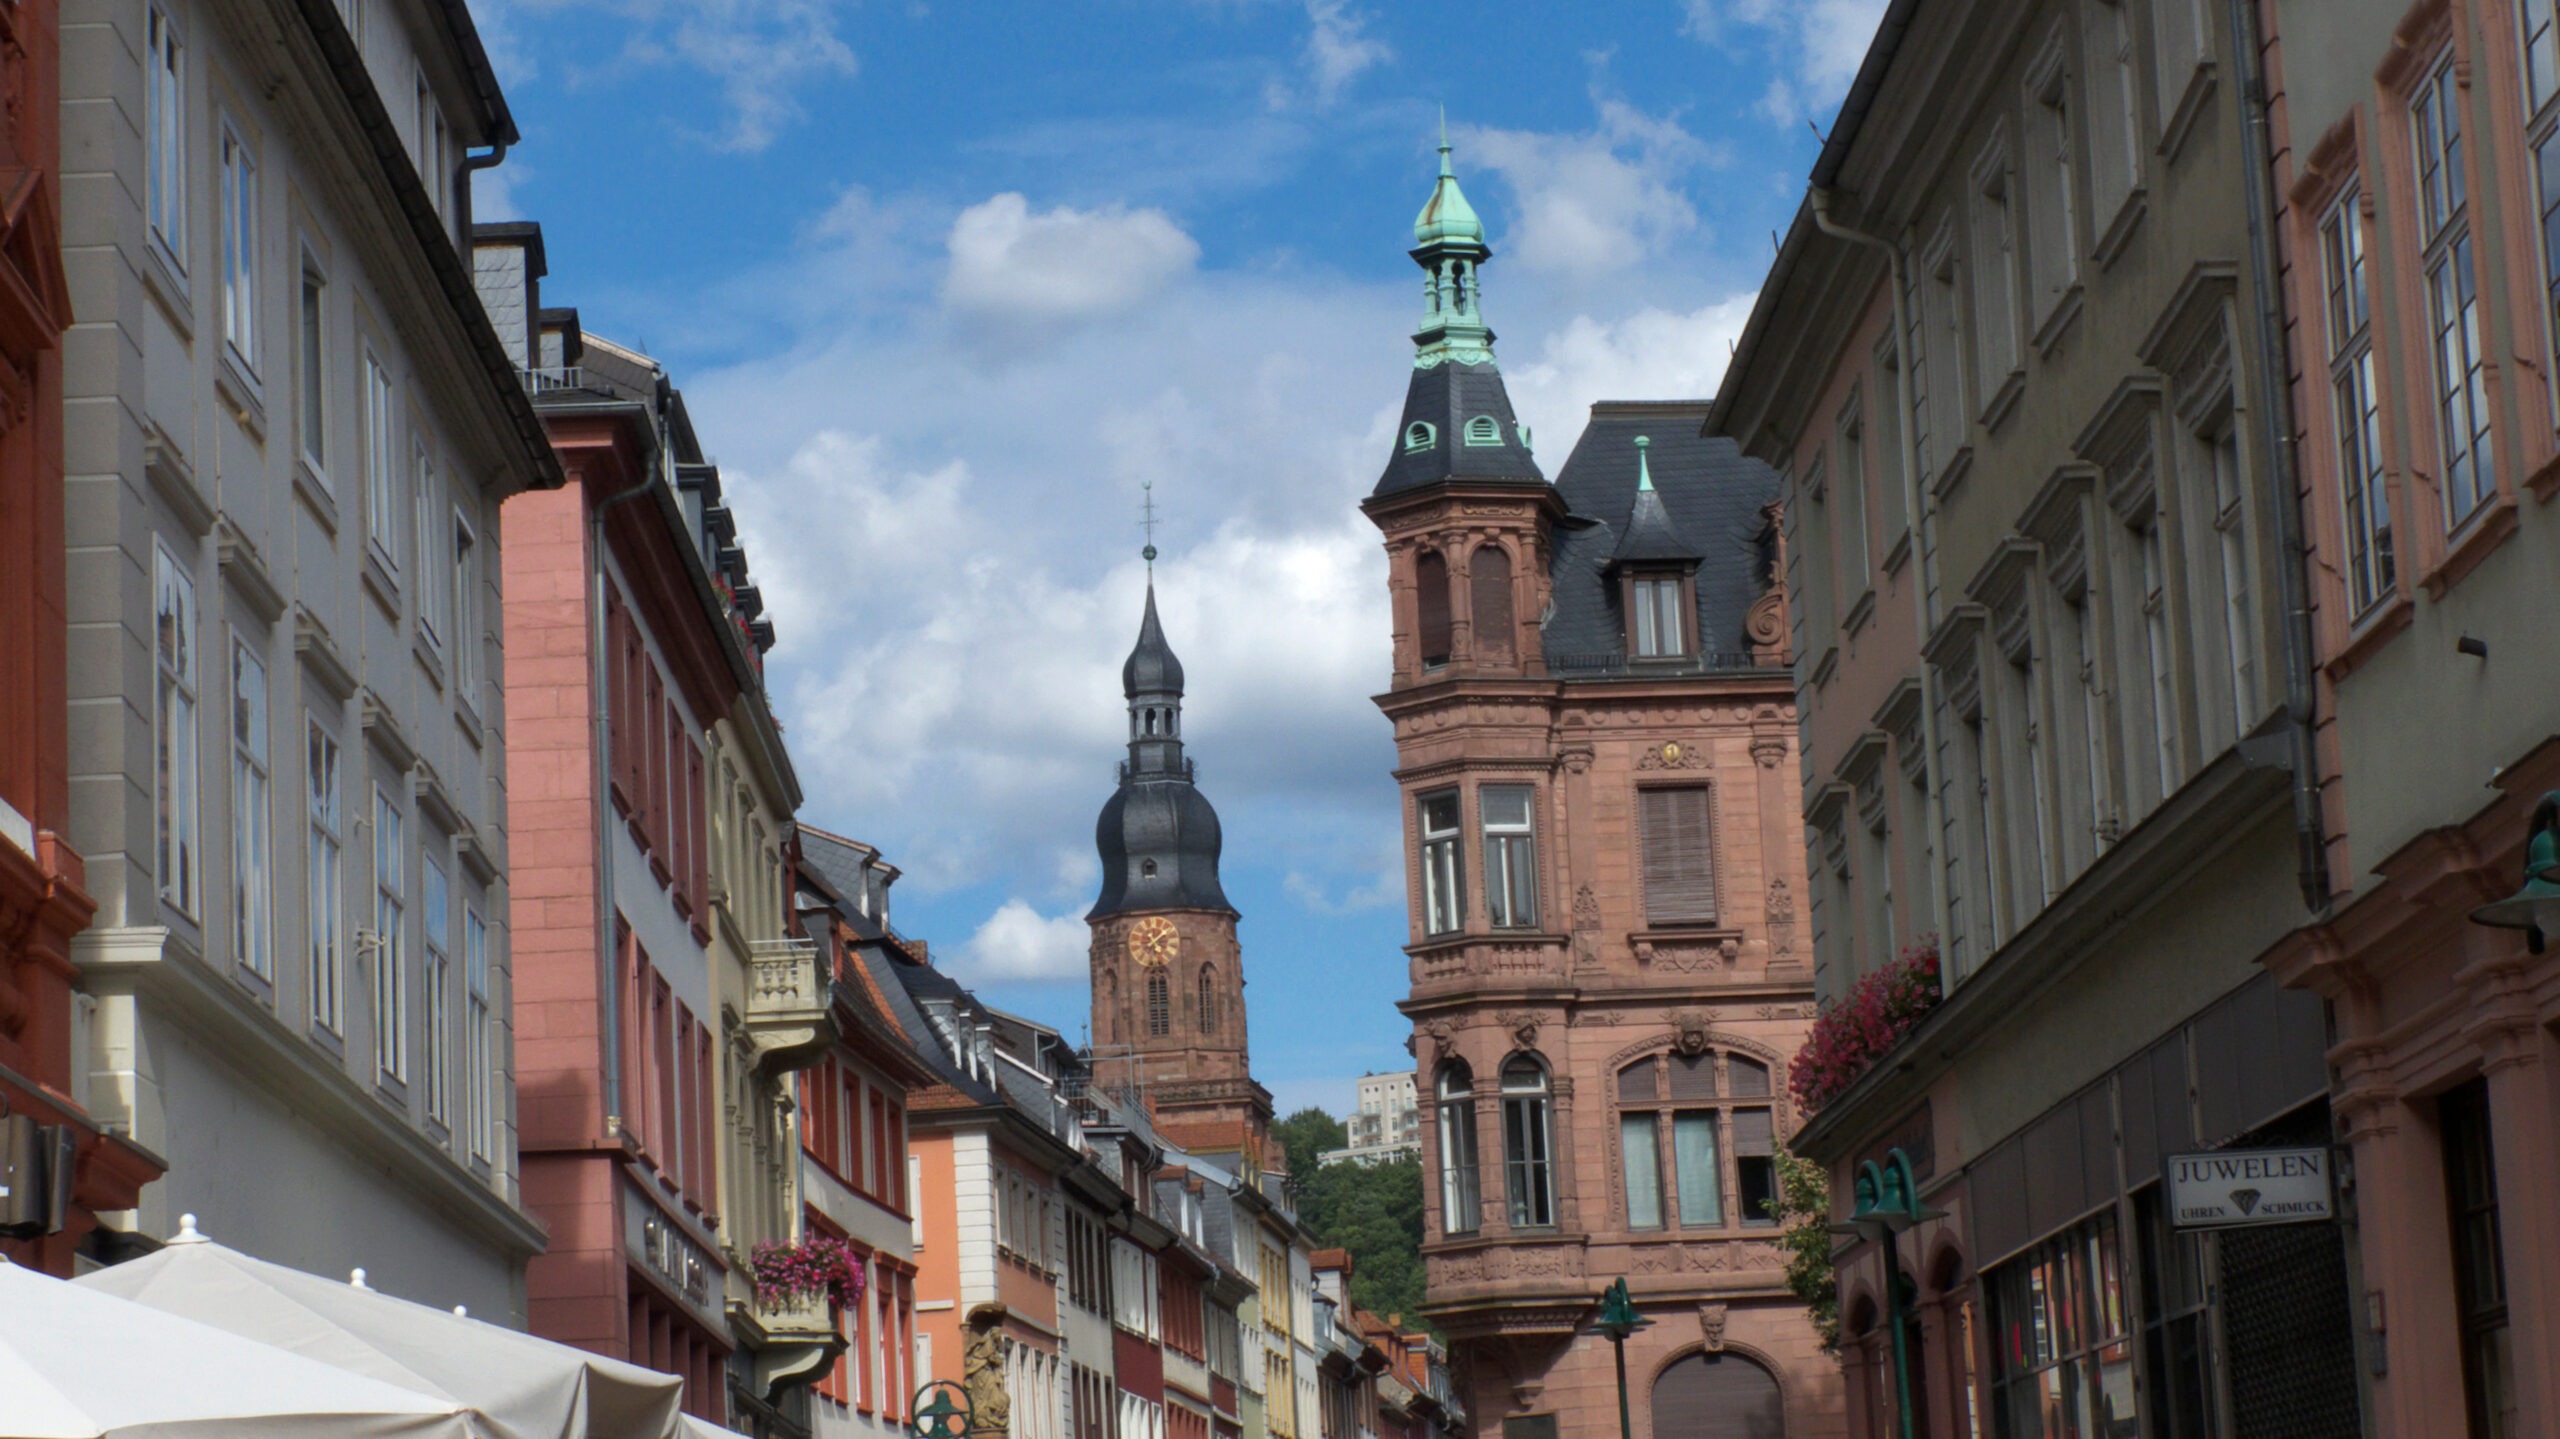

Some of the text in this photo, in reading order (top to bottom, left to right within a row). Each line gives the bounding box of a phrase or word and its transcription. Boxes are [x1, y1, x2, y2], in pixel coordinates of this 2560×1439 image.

[2178, 1155, 2319, 1183] JUWELEN
[2181, 1201, 2325, 1219] UHREN SCHMUCK
